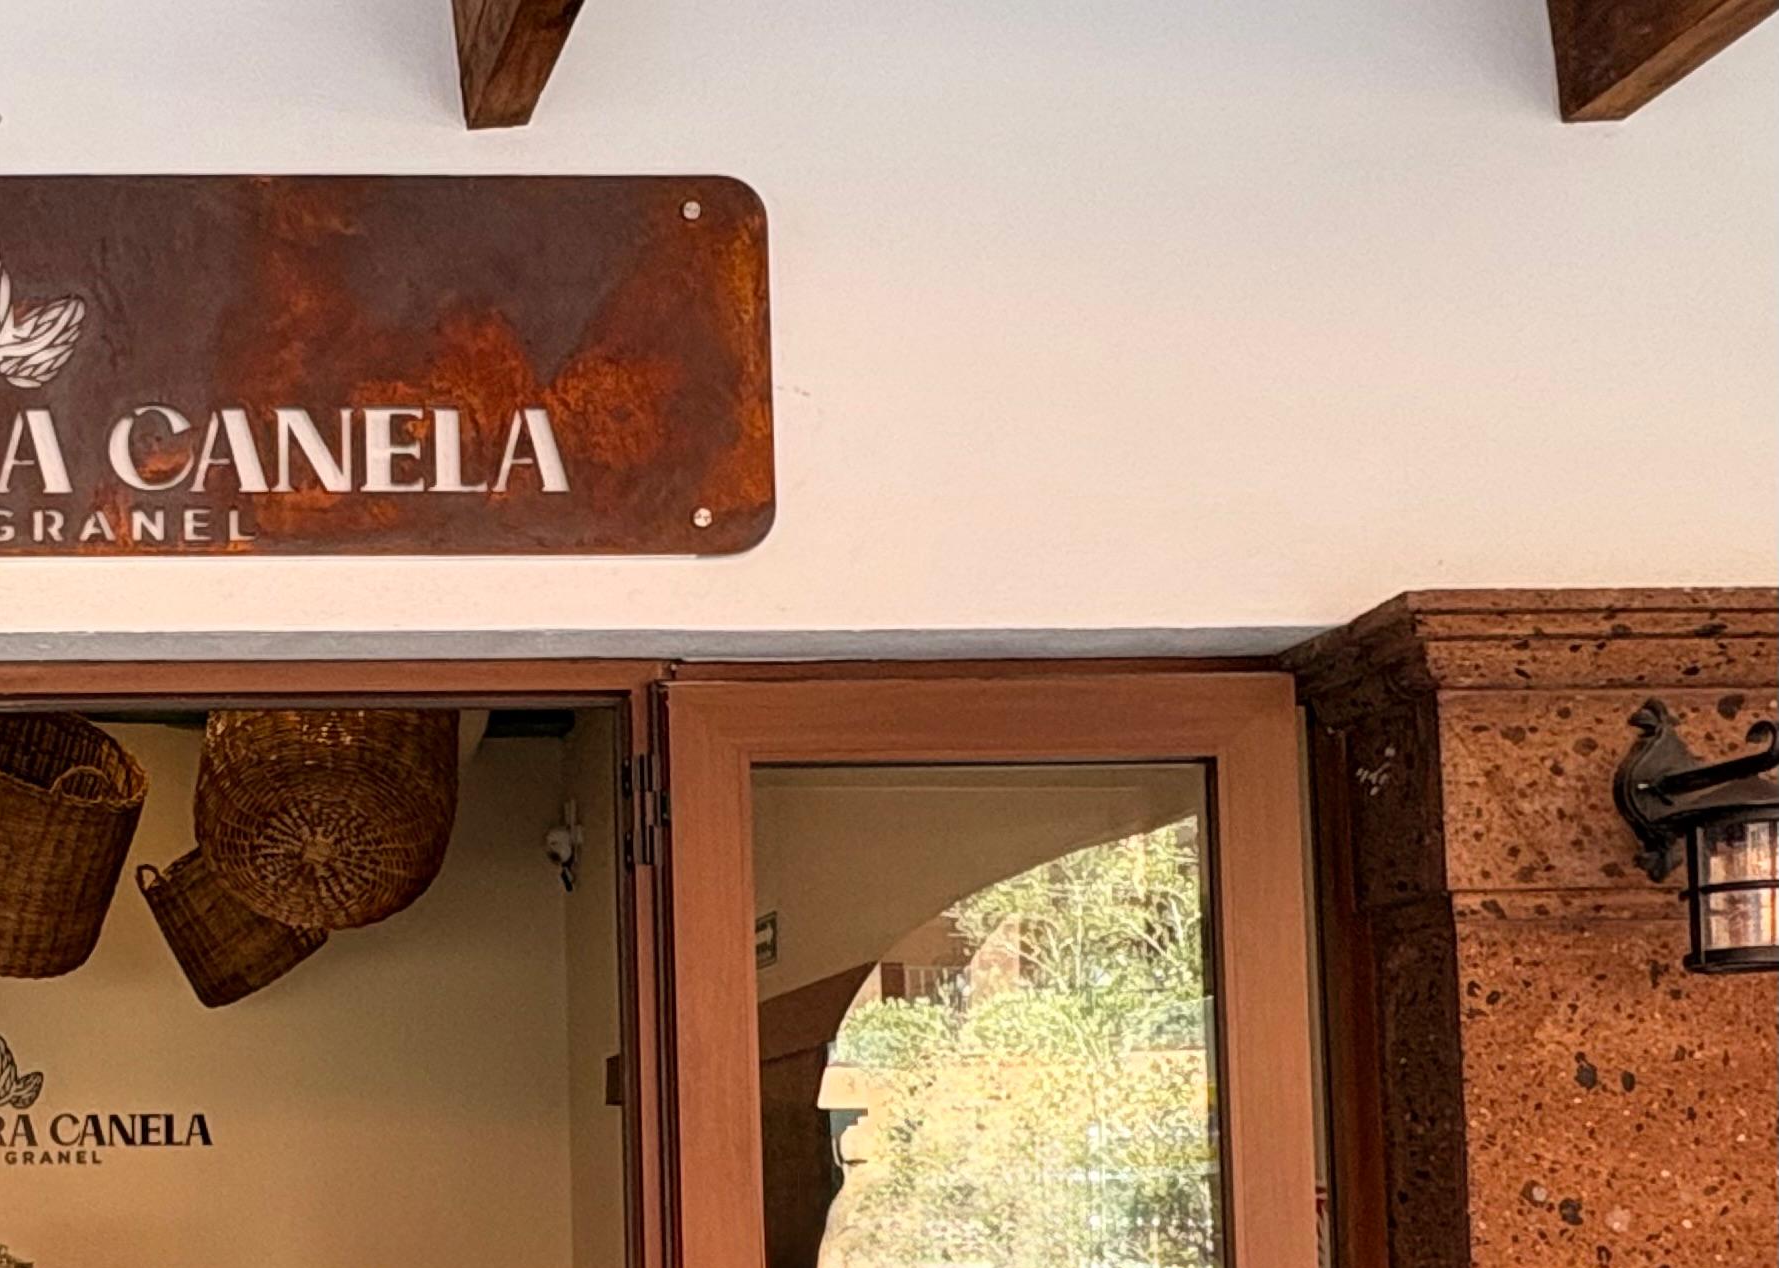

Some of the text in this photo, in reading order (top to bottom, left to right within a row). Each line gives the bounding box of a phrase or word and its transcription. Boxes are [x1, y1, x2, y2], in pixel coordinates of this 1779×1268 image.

[108, 404, 571, 494] CANELA
[49, 1113, 213, 1148] CANELA
[4, 1149, 103, 1166] GRANEL
